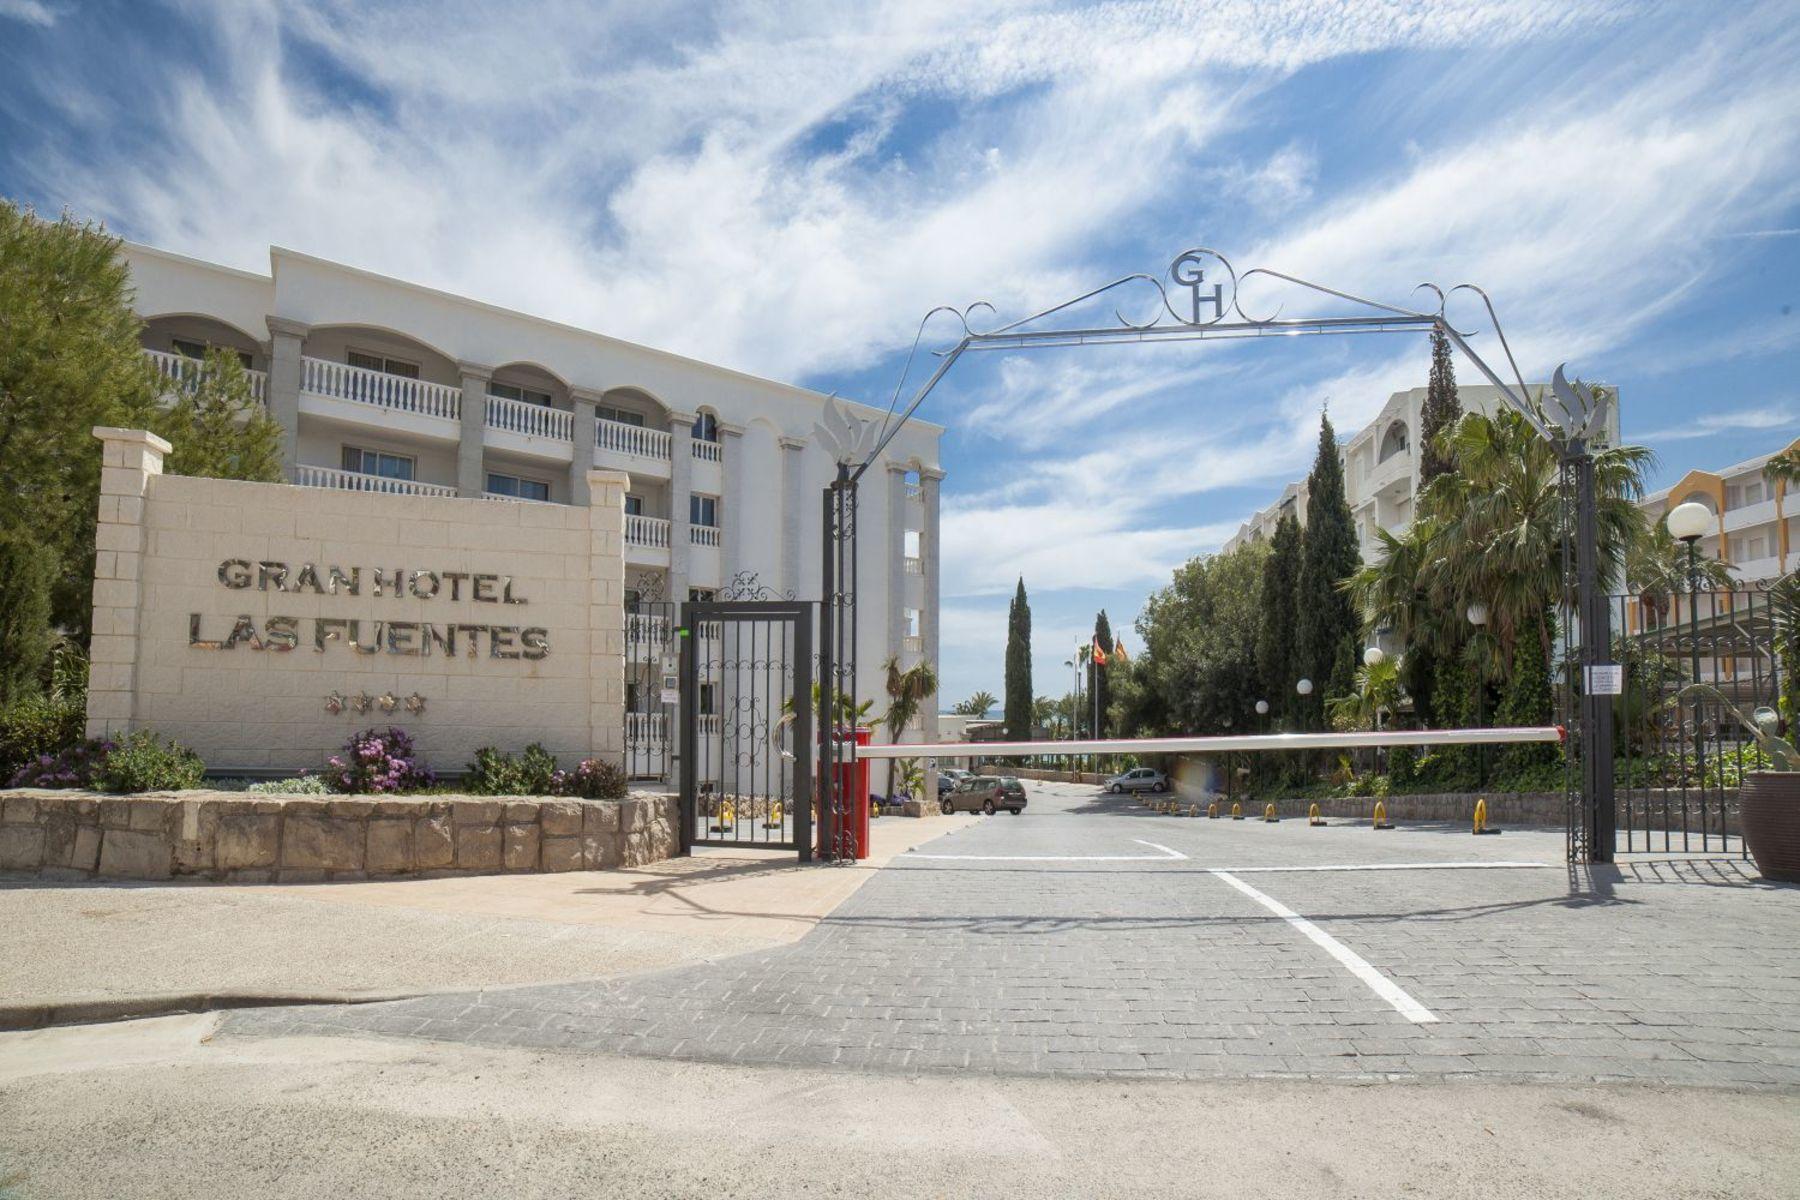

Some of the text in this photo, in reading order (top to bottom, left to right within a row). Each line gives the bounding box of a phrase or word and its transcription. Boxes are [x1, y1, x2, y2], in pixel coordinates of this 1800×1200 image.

[217, 557, 529, 605] GRAN HOTEL
[188, 613, 552, 661] LAS FUENTES
